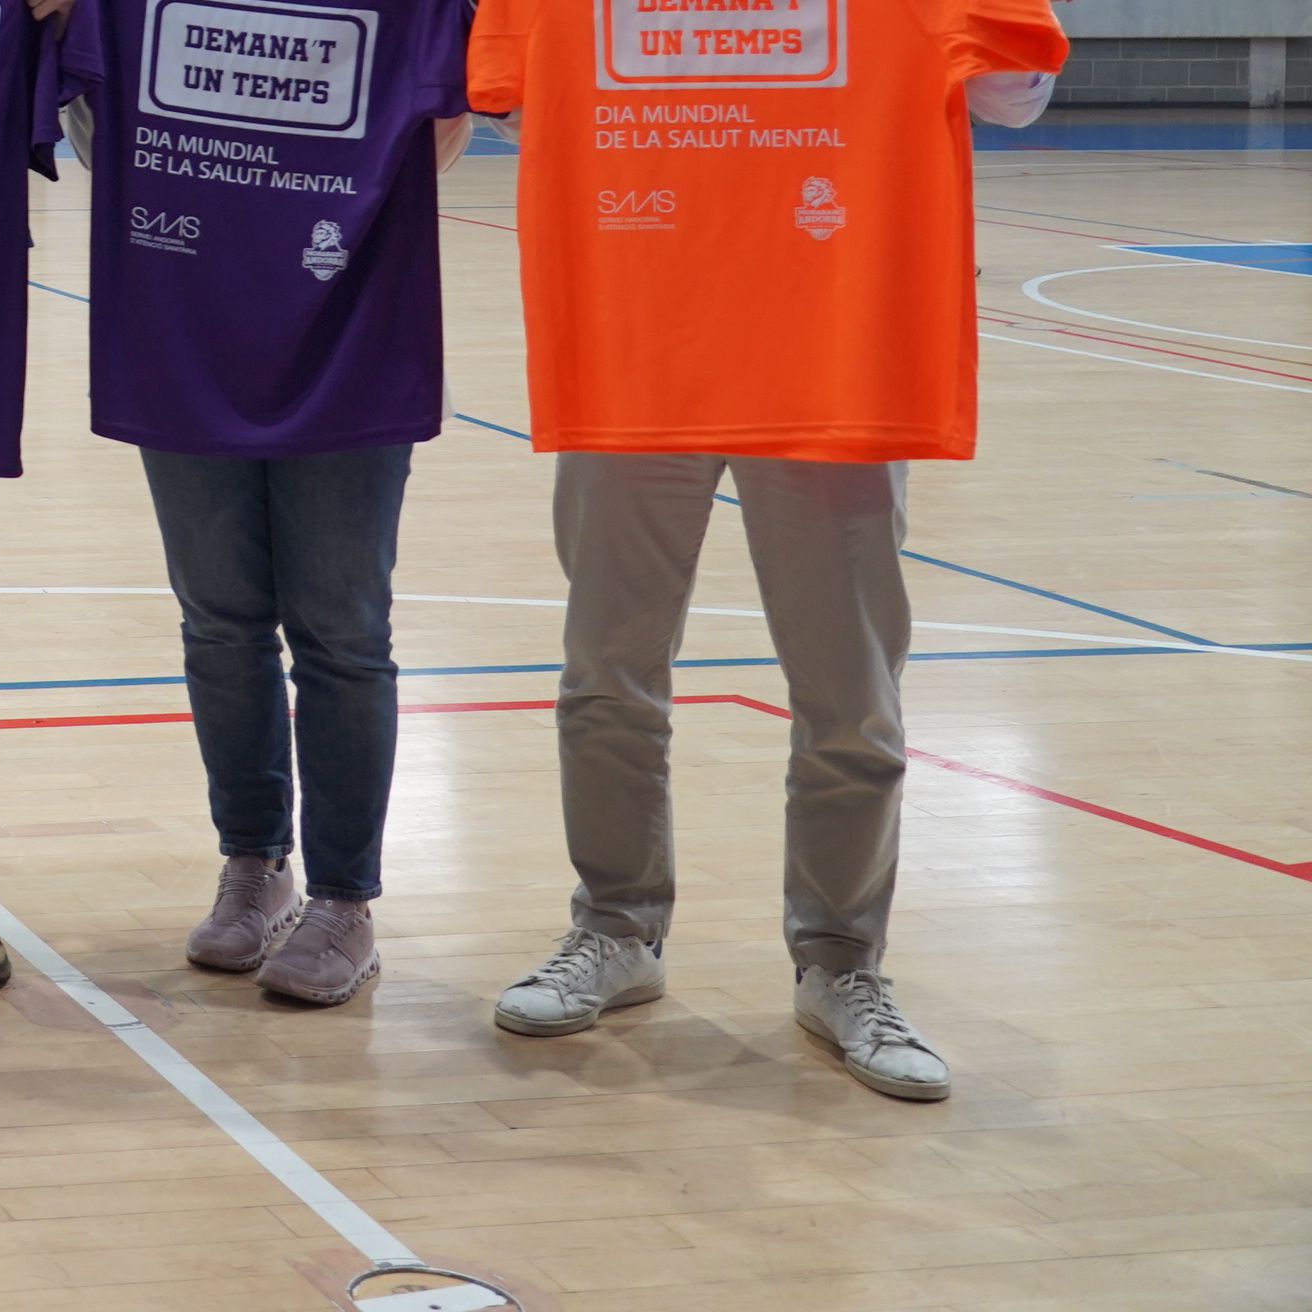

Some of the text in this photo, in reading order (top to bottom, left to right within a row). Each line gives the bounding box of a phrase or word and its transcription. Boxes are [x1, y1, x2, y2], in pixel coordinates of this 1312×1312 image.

[185, 24, 336, 64] DEMANA'T
[640, 29, 802, 56] UN TEMPS
[184, 65, 330, 105] UN TEMPS
[596, 105, 755, 124] DIA MUNDIAL
[136, 127, 279, 165] DIA MUNDIAL
[596, 129, 845, 149] DE LA SALUT MENTAL
[134, 150, 357, 194] DE LA SALUT MENTAL
